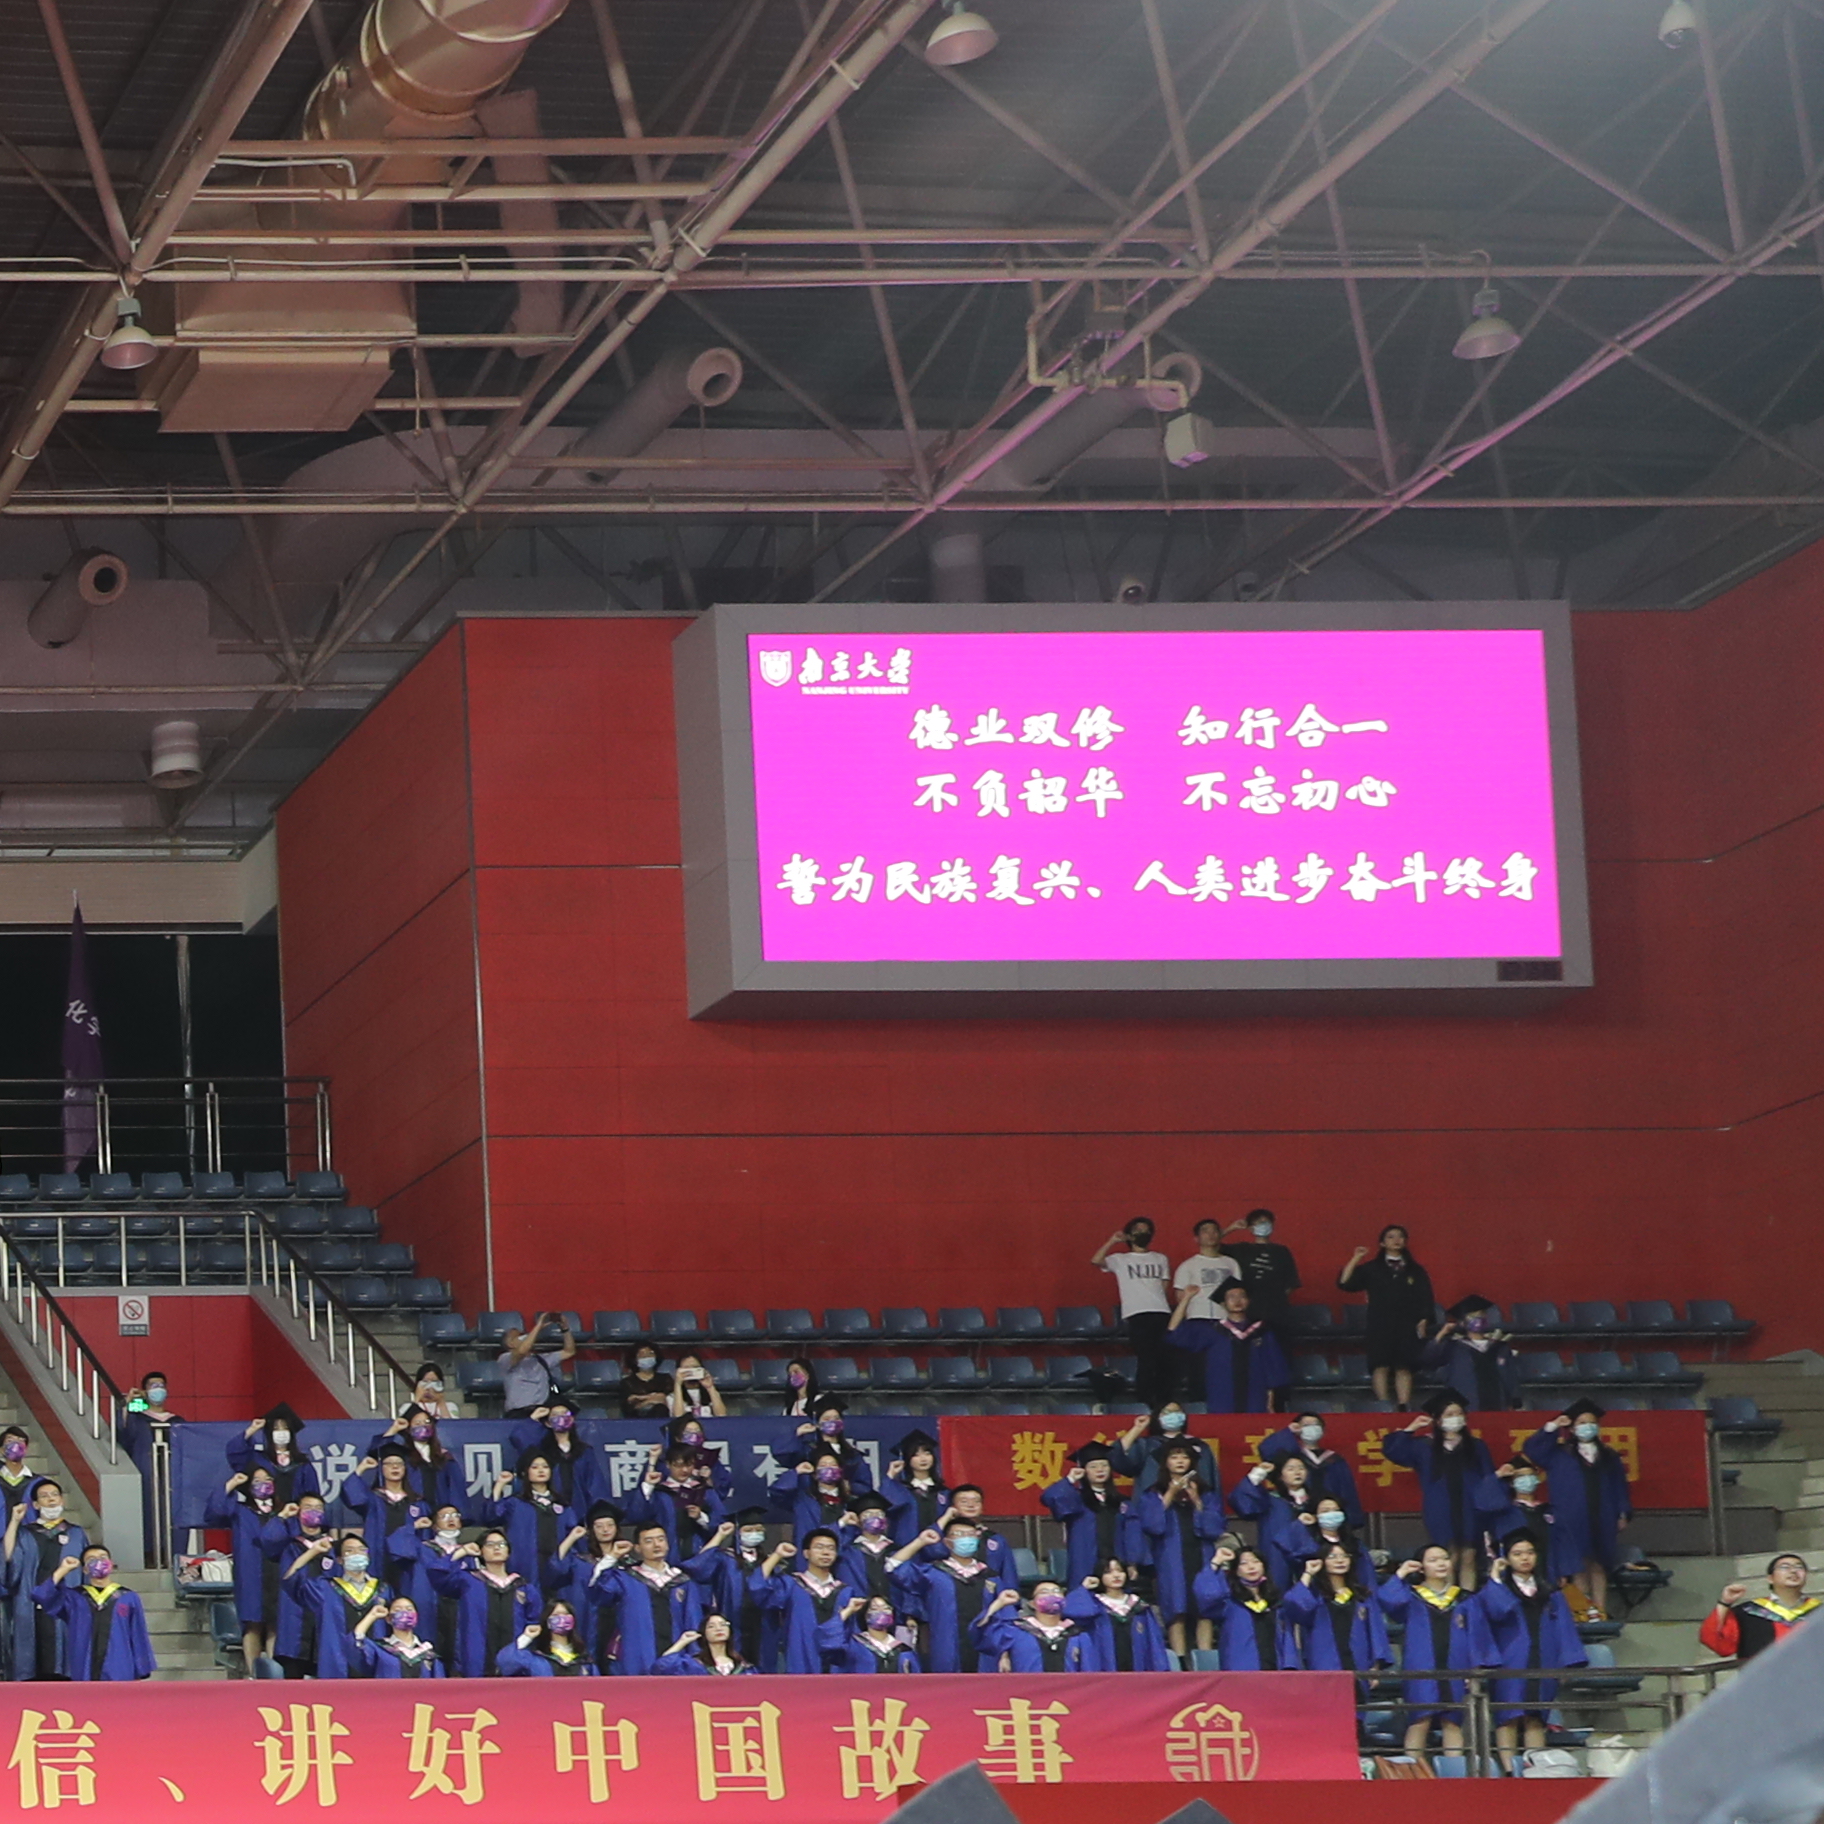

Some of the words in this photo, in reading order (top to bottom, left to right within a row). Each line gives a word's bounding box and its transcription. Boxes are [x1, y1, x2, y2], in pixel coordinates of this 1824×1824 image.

[909, 703, 1126, 752] 德业双修
[1178, 704, 1390, 751] 知行合一
[914, 766, 1125, 820] 不负韶华
[1183, 766, 1399, 816] 不忘初心
